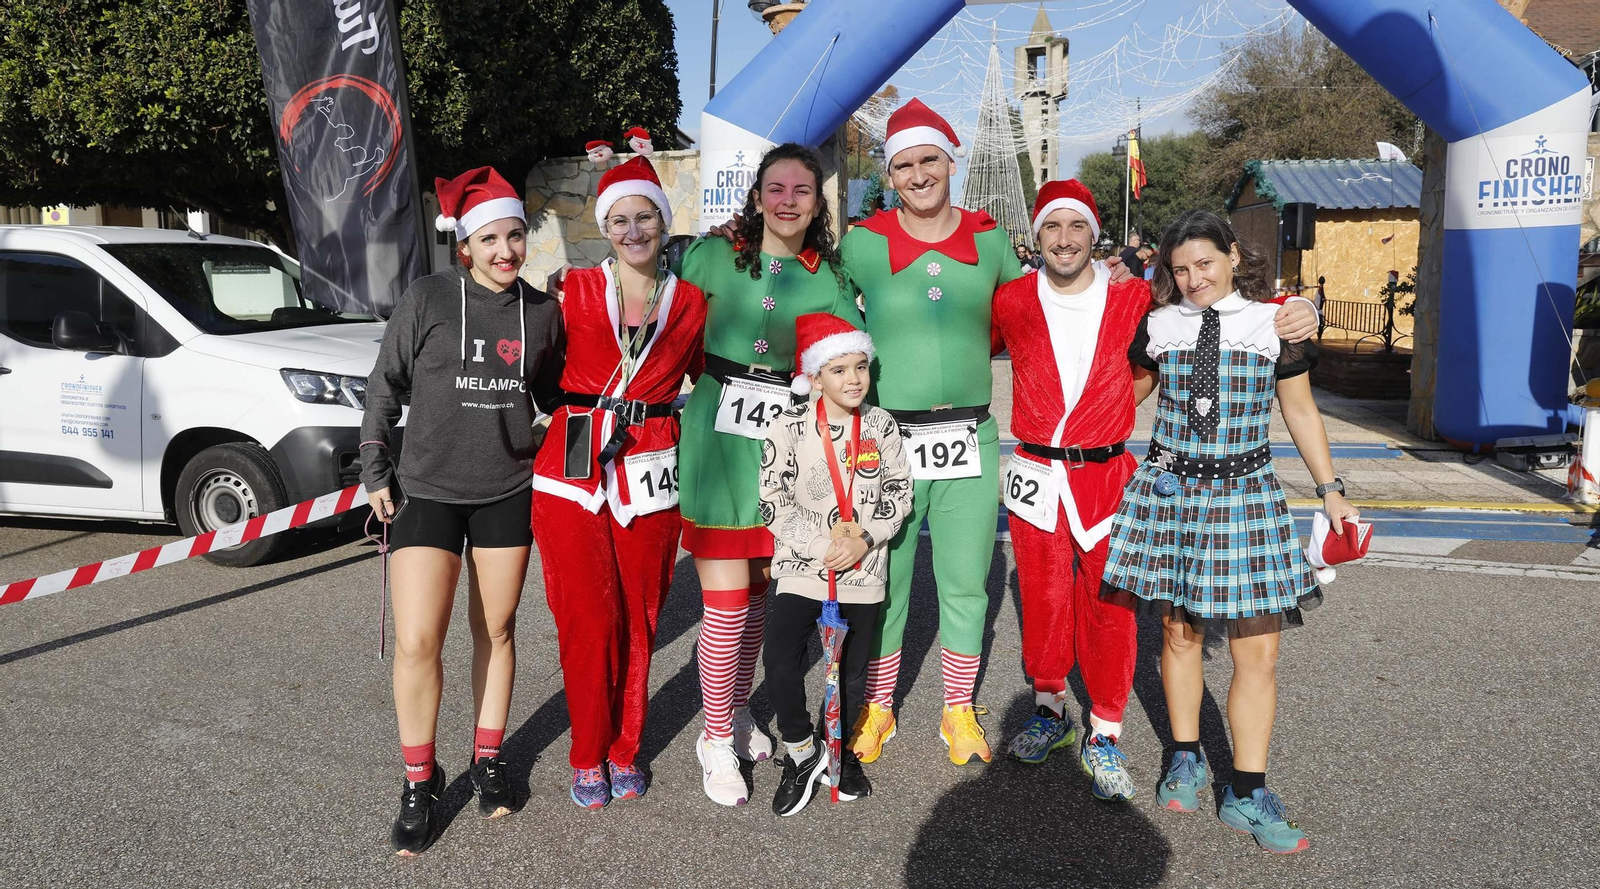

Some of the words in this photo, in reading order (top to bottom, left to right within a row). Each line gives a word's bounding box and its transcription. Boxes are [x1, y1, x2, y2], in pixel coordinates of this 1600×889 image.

[1506, 156, 1570, 178] CRONO
[716, 170, 757, 188] CRON
[703, 187, 746, 213] FINIS
[1478, 175, 1582, 208] FINISHER
[472, 339, 486, 362] I
[455, 376, 527, 393] MELAMPO
[61, 425, 79, 436] 644
[82, 427, 98, 438] 955
[101, 429, 114, 439] 141
[846, 451, 880, 468] CMICS
[914, 440, 968, 468] 192
[1006, 470, 1039, 507] 162
